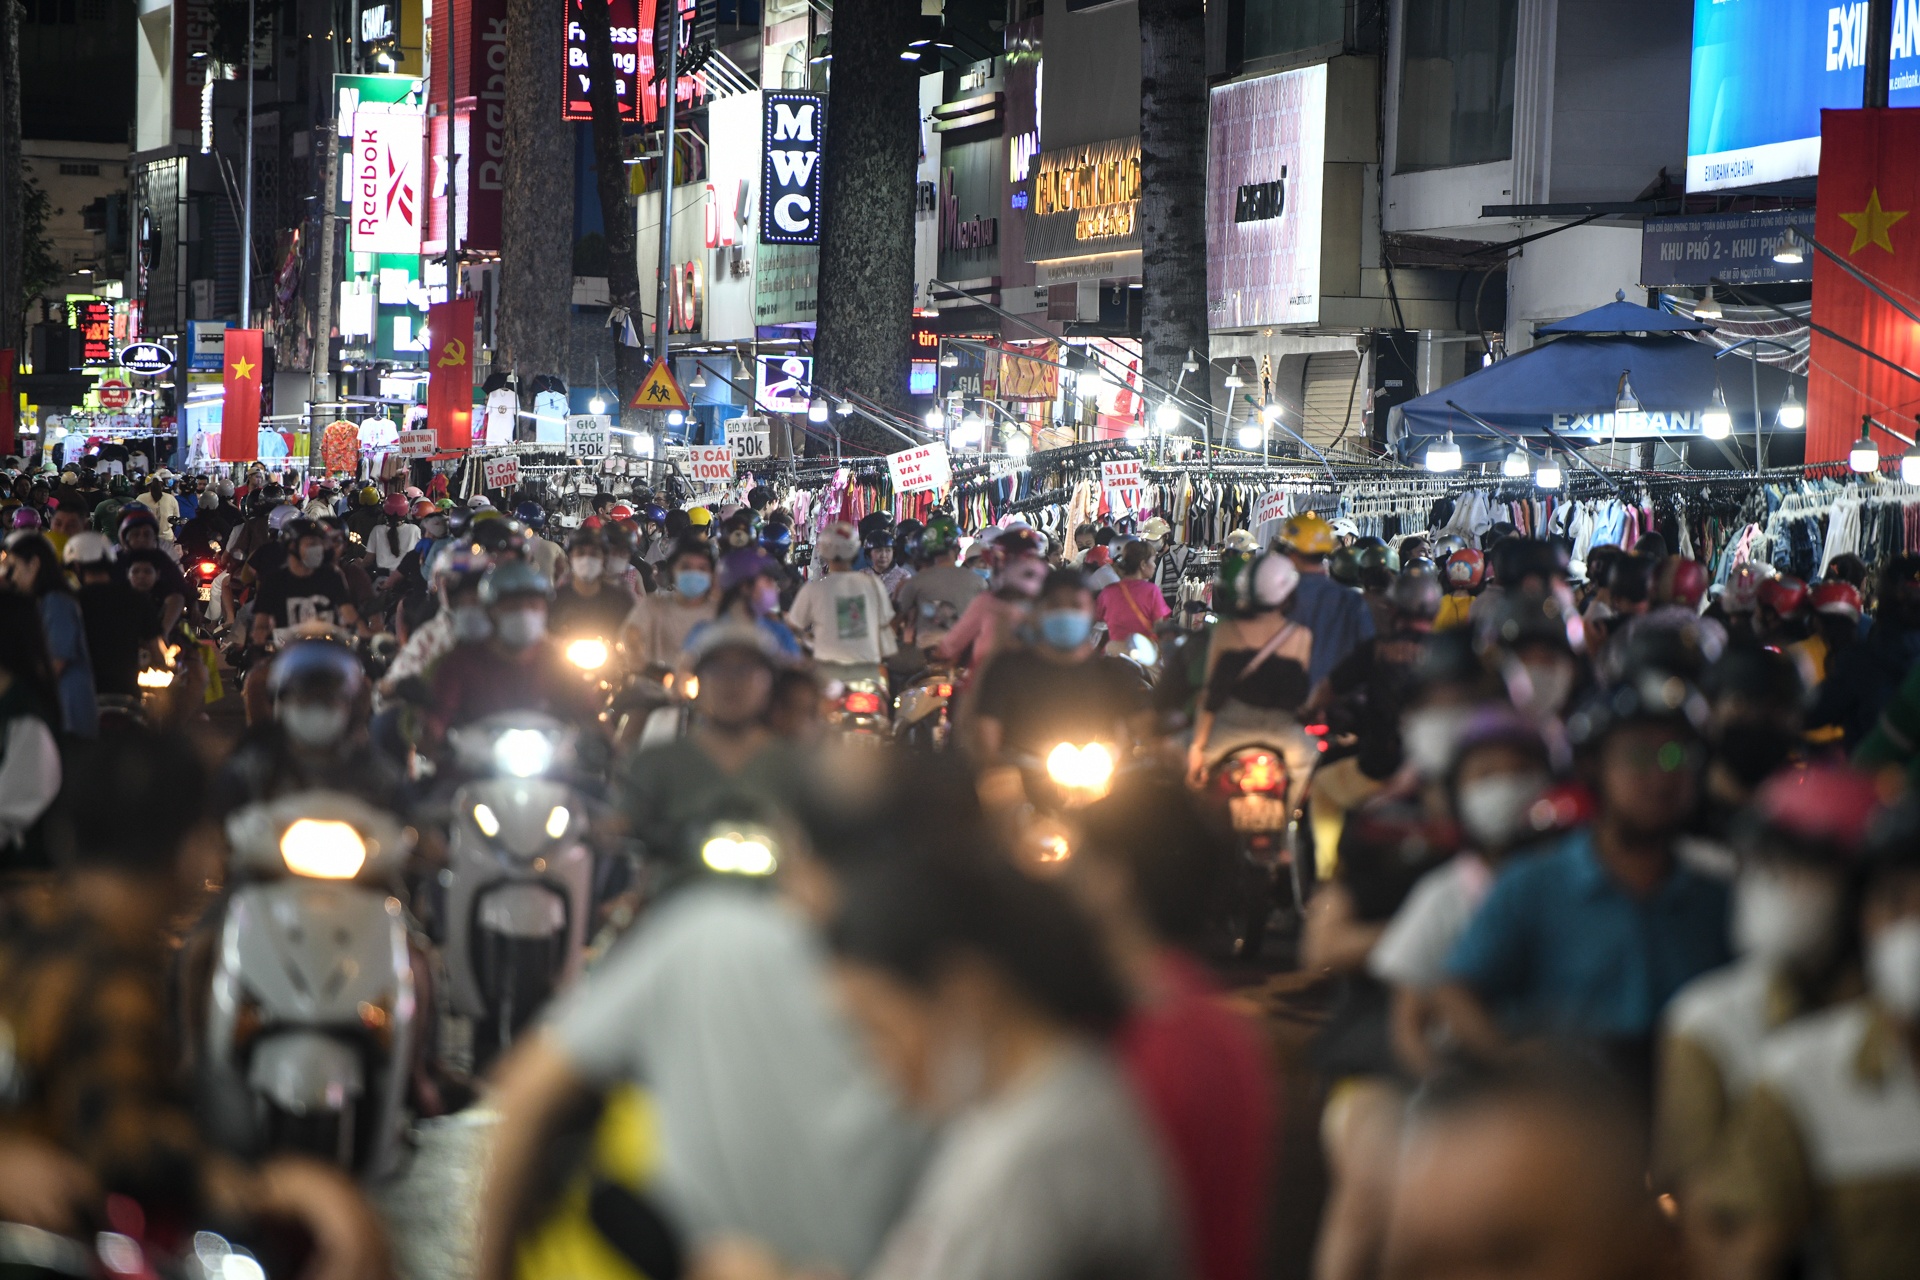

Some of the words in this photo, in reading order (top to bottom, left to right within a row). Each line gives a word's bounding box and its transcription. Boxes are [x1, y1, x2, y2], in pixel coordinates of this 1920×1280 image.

[1705, 163, 1730, 182] EXIMBANK
[358, 129, 379, 235] Reebok
[1660, 242, 1683, 260] KHU
[1686, 234, 1711, 260] PHỐ
[1712, 240, 1721, 260] 2
[1731, 238, 1757, 258] KHU
[958, 373, 980, 394] GIÁ
[415, 433, 432, 443] THUN
[401, 446, 417, 454] NAM
[569, 443, 604, 456] 150k
[728, 436, 763, 457] 150k
[691, 451, 699, 462] 3
[703, 447, 731, 462] CÁI
[486, 466, 494, 475] 3
[497, 460, 517, 474] CÁI
[692, 463, 731, 479] 100K
[900, 464, 921, 476] VÁY
[1104, 462, 1141, 475] SALE
[489, 474, 518, 488] 100K
[1108, 477, 1139, 487] 50K
[1260, 499, 1265, 509] 3
[1258, 505, 1285, 524] 100K
